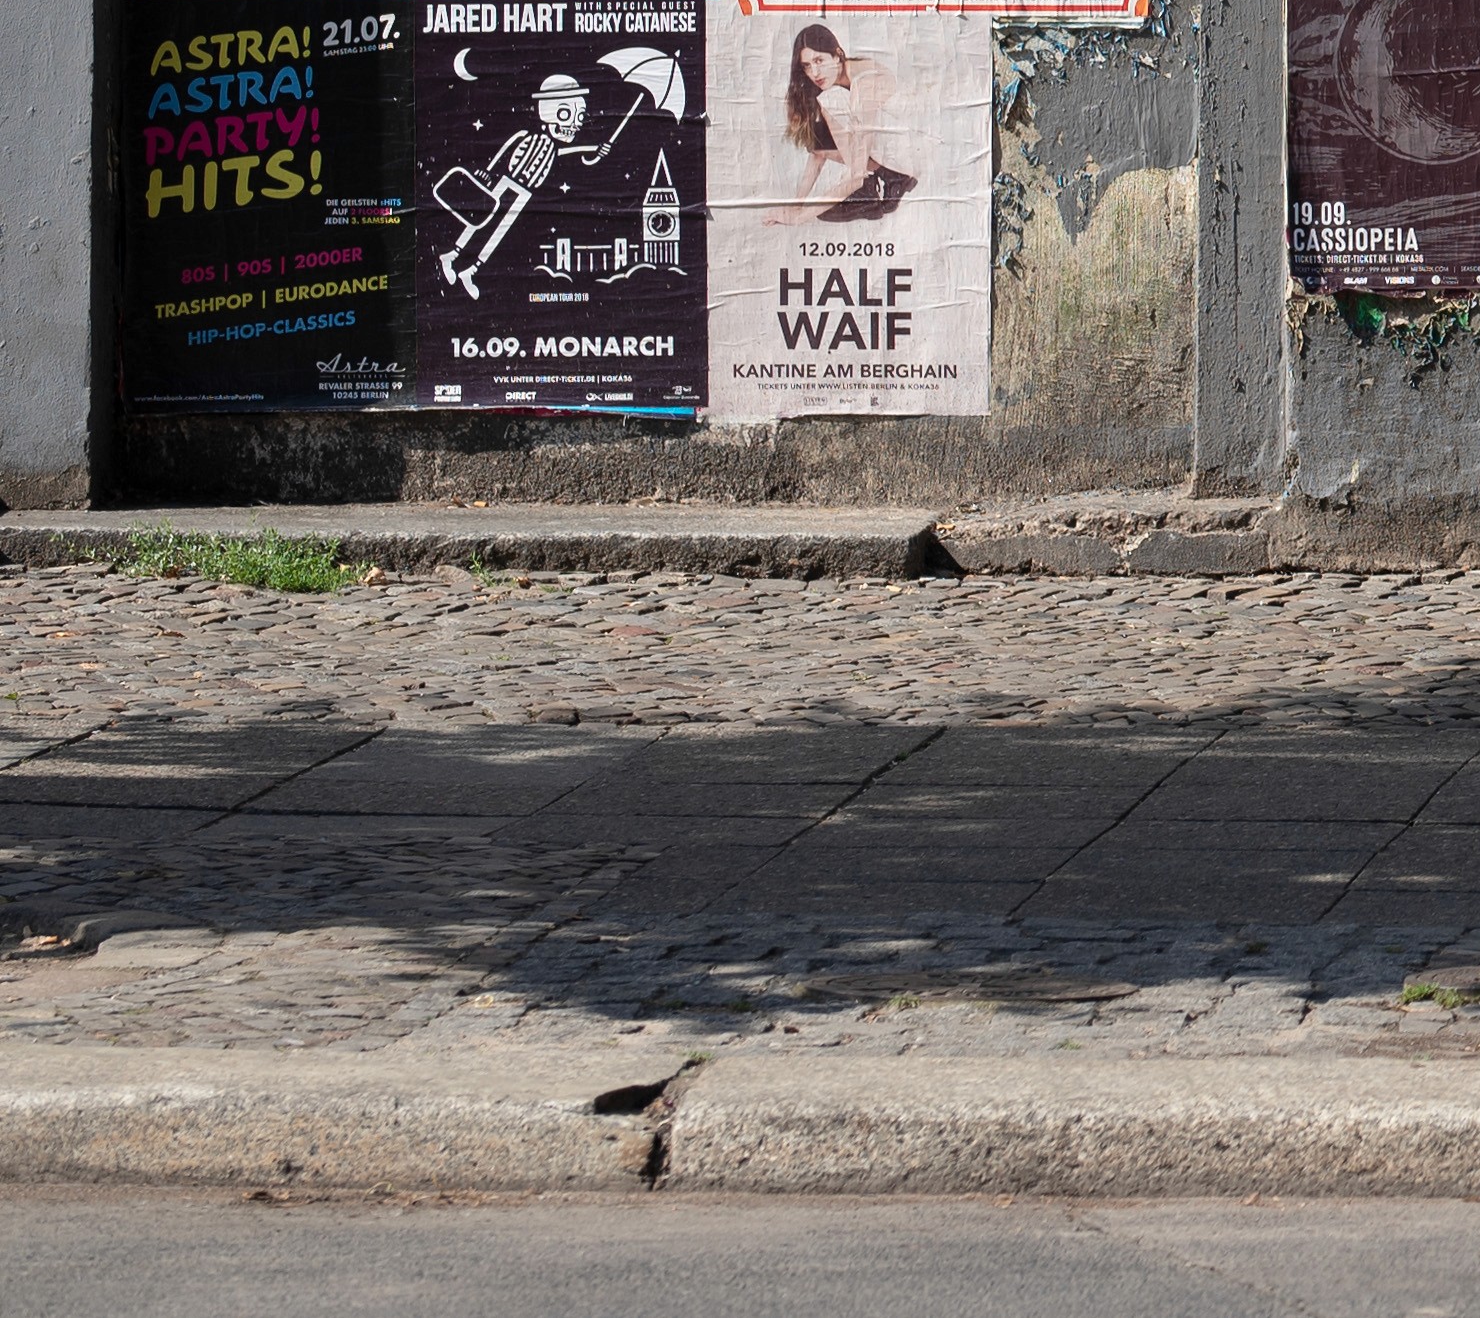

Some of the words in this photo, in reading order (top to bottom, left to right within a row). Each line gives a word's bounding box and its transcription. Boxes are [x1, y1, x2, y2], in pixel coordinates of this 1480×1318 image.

[423, 4, 497, 34] JARED
[503, 3, 567, 33] HART
[575, 13, 623, 34] ROCKY
[625, 12, 696, 33] CATANESE
[1292, 202, 1351, 226] 19.09.
[1293, 227, 1419, 252] CASSIOPEIA
[780, 268, 912, 307] HALF
[777, 311, 912, 350] WAIF
[451, 337, 527, 357] 16.09.
[534, 336, 674, 357] MONARCH
